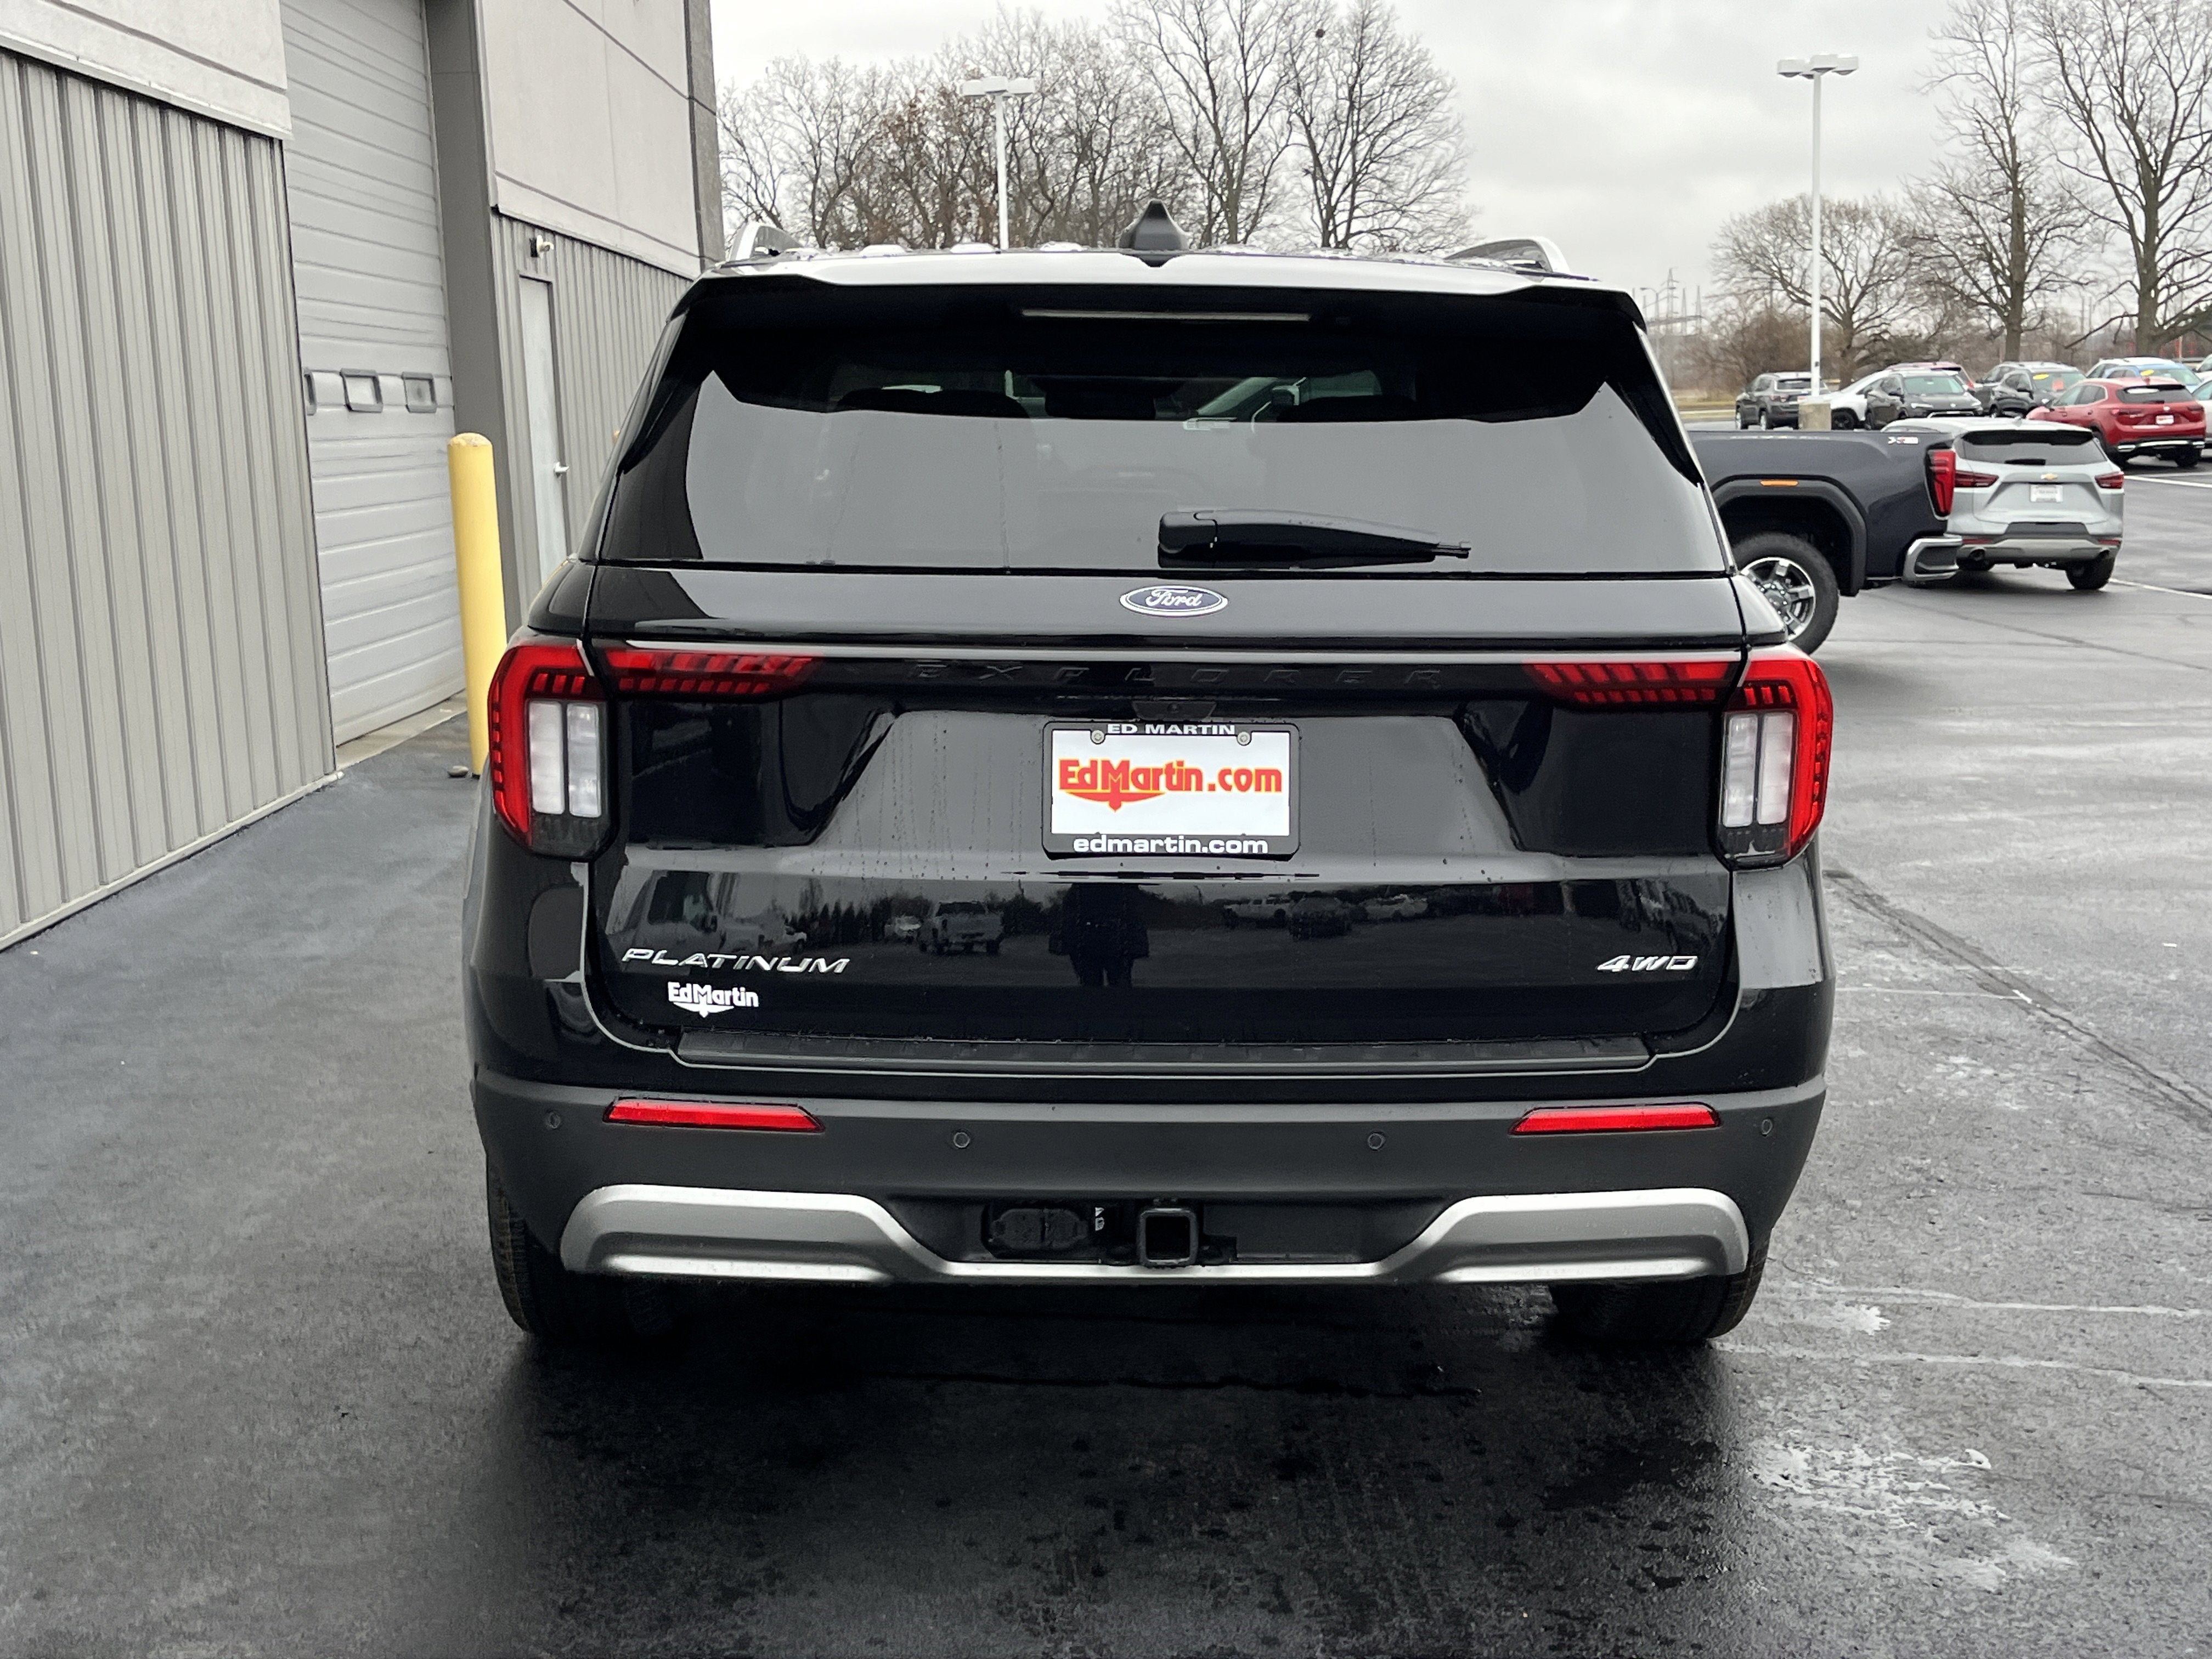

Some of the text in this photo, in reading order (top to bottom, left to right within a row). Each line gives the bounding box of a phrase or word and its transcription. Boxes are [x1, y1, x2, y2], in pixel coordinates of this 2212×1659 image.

[1146, 589, 1203, 607] Ford
[912, 663, 1441, 685] EXPLORER
[1107, 724, 1235, 735] ED MARTIN
[1059, 759, 1282, 792] EdMartin.com
[1073, 835, 1268, 854] edmartin.com
[621, 948, 850, 973] PLATINUM
[1597, 955, 1698, 972] 4WD
[668, 981, 759, 1007] EdMartin
